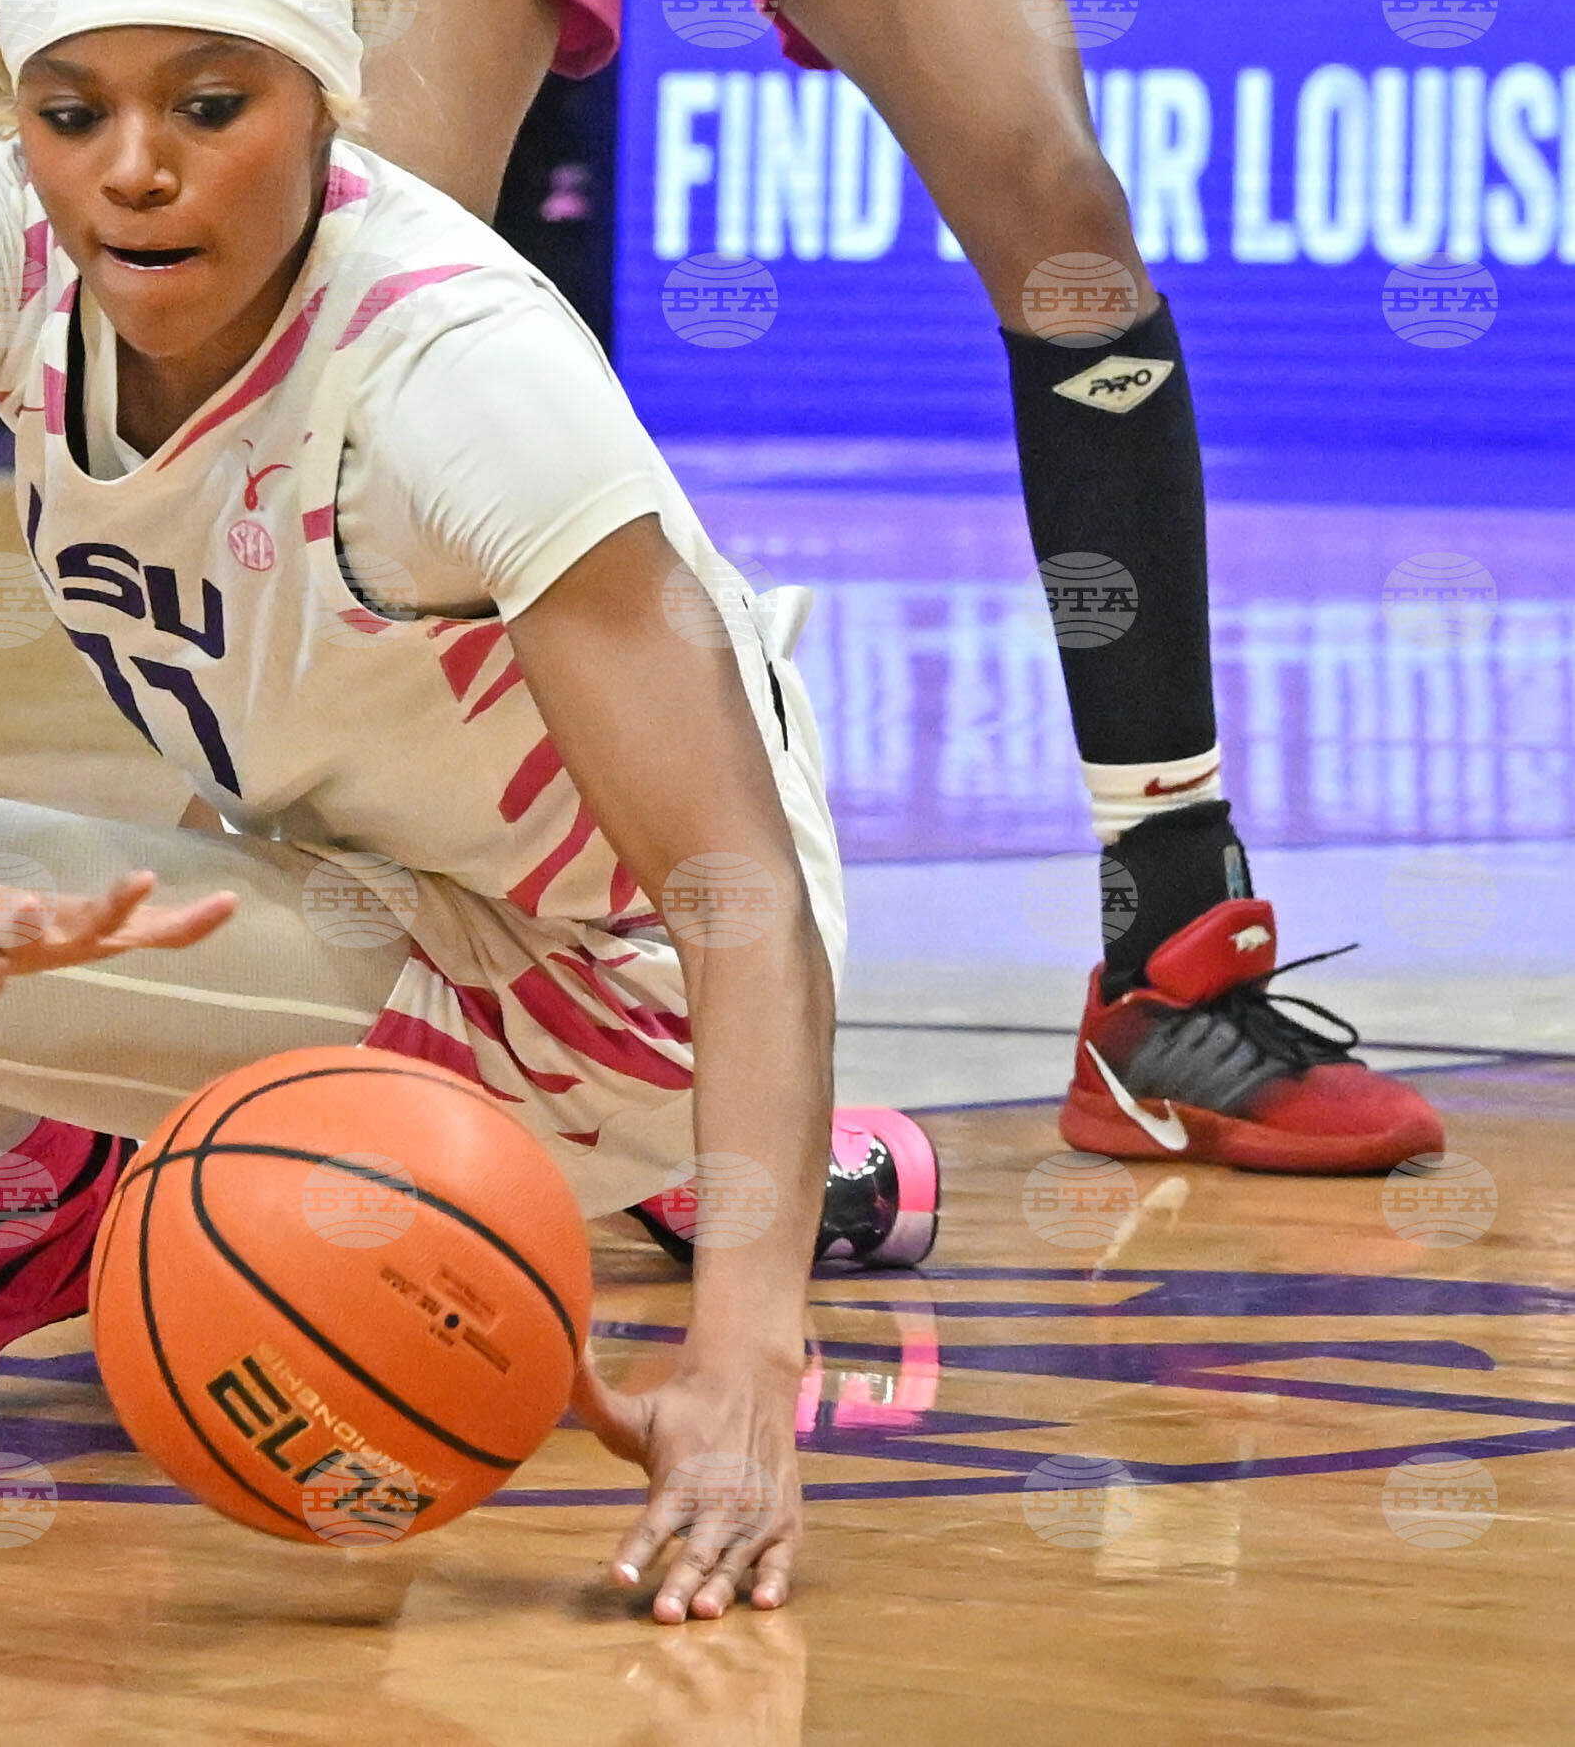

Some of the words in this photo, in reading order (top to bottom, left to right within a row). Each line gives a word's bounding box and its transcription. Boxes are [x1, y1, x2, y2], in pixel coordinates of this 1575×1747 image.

[654, 68, 904, 262] FIND
[1088, 369, 1152, 396] PRO
[62, 623, 243, 800] 11
